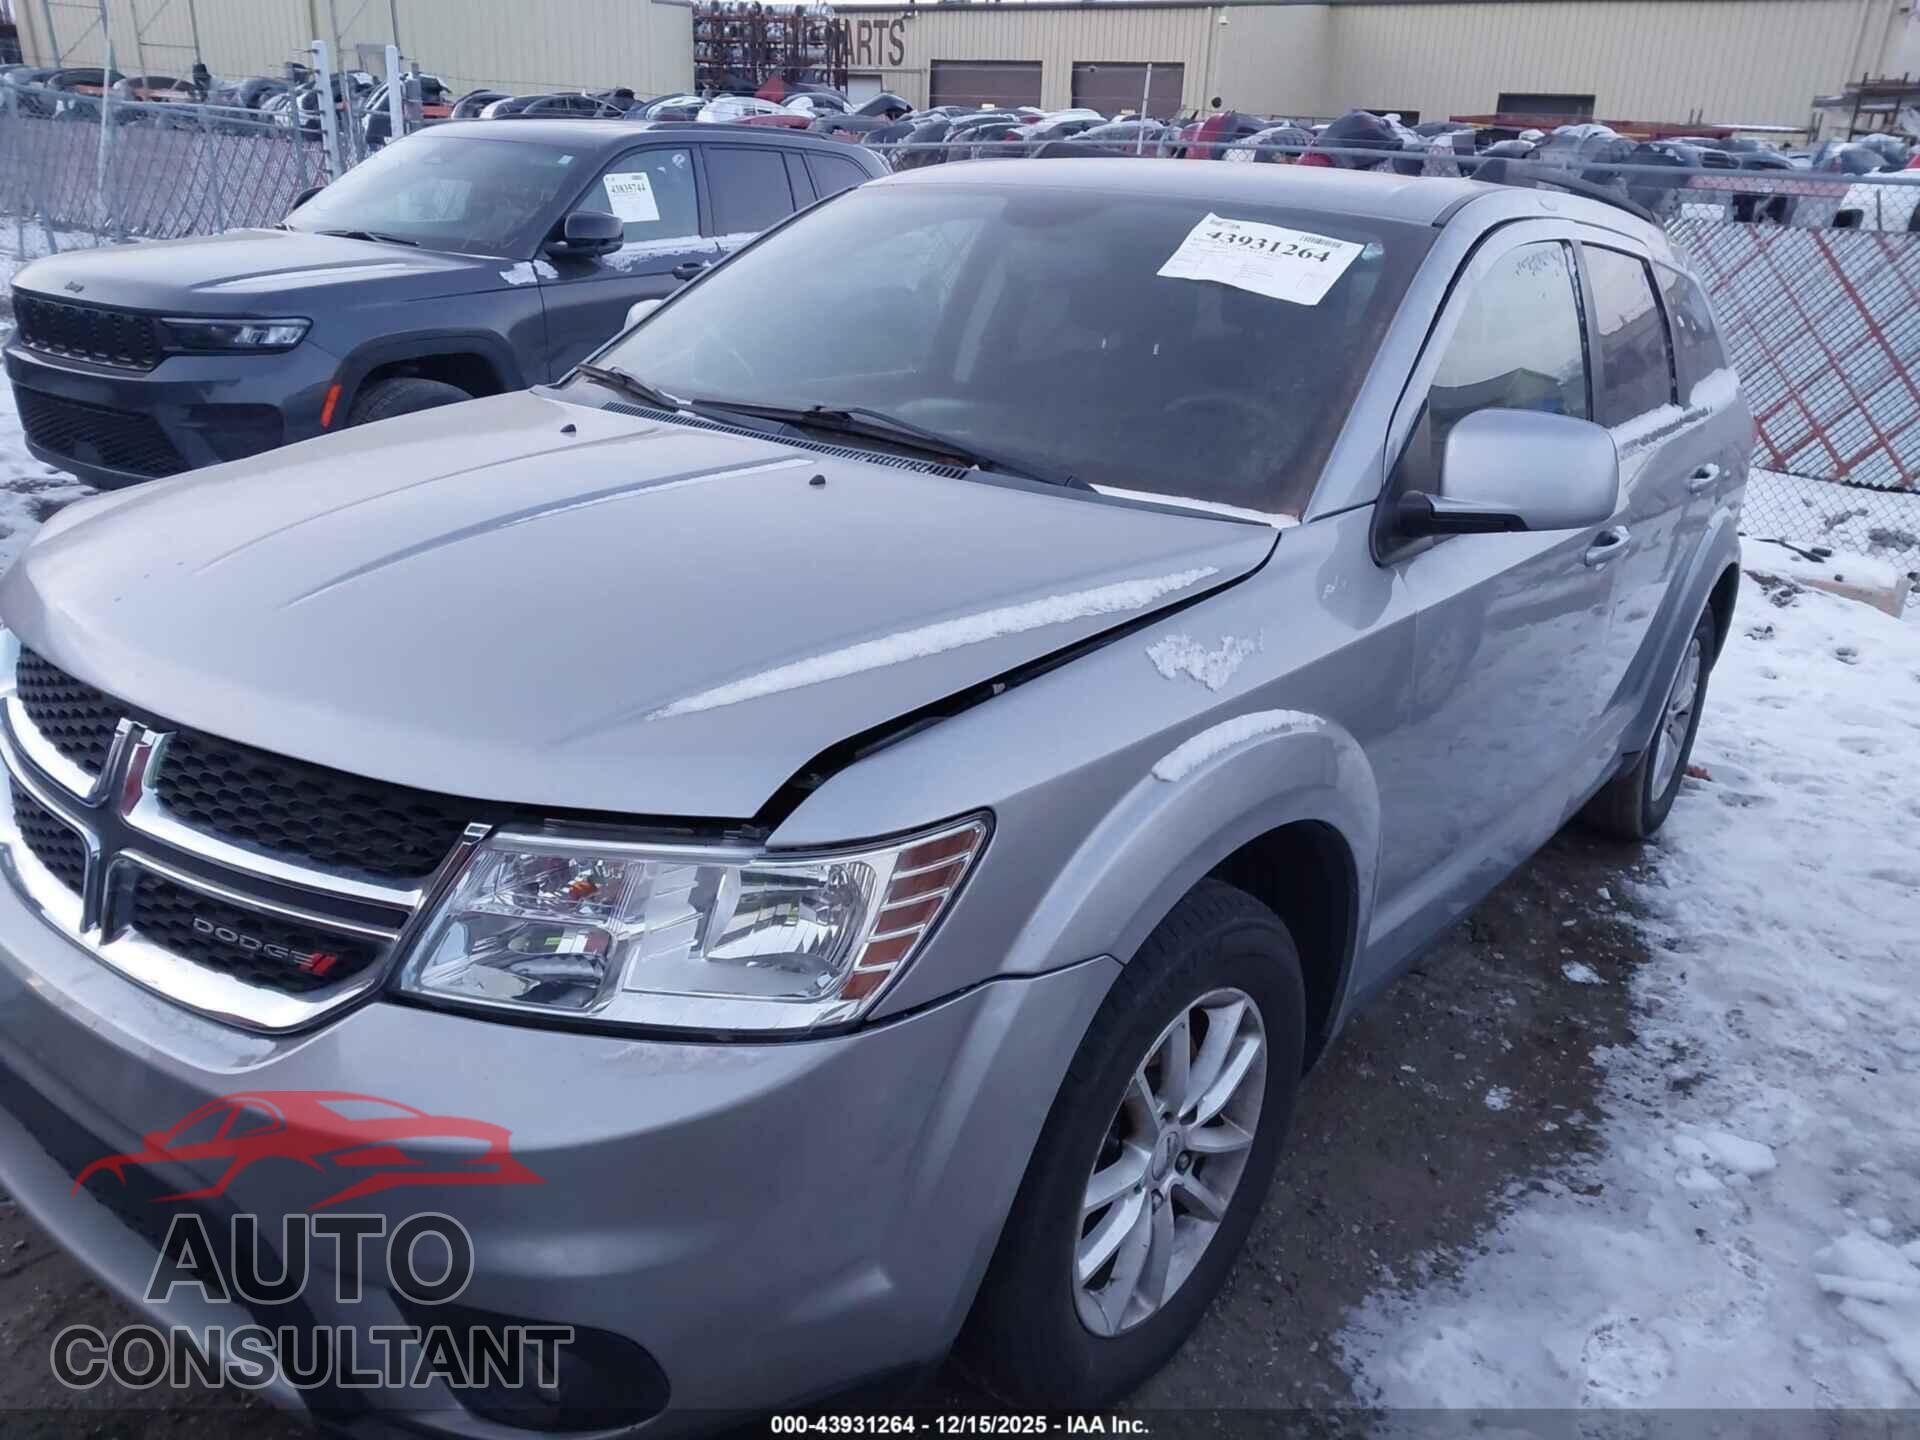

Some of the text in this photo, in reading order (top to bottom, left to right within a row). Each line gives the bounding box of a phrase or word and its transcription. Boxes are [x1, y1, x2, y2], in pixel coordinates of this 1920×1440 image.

[835, 18, 905, 66] ARTS
[1206, 231, 1330, 262] 43931264
[193, 917, 314, 967] DODGE
